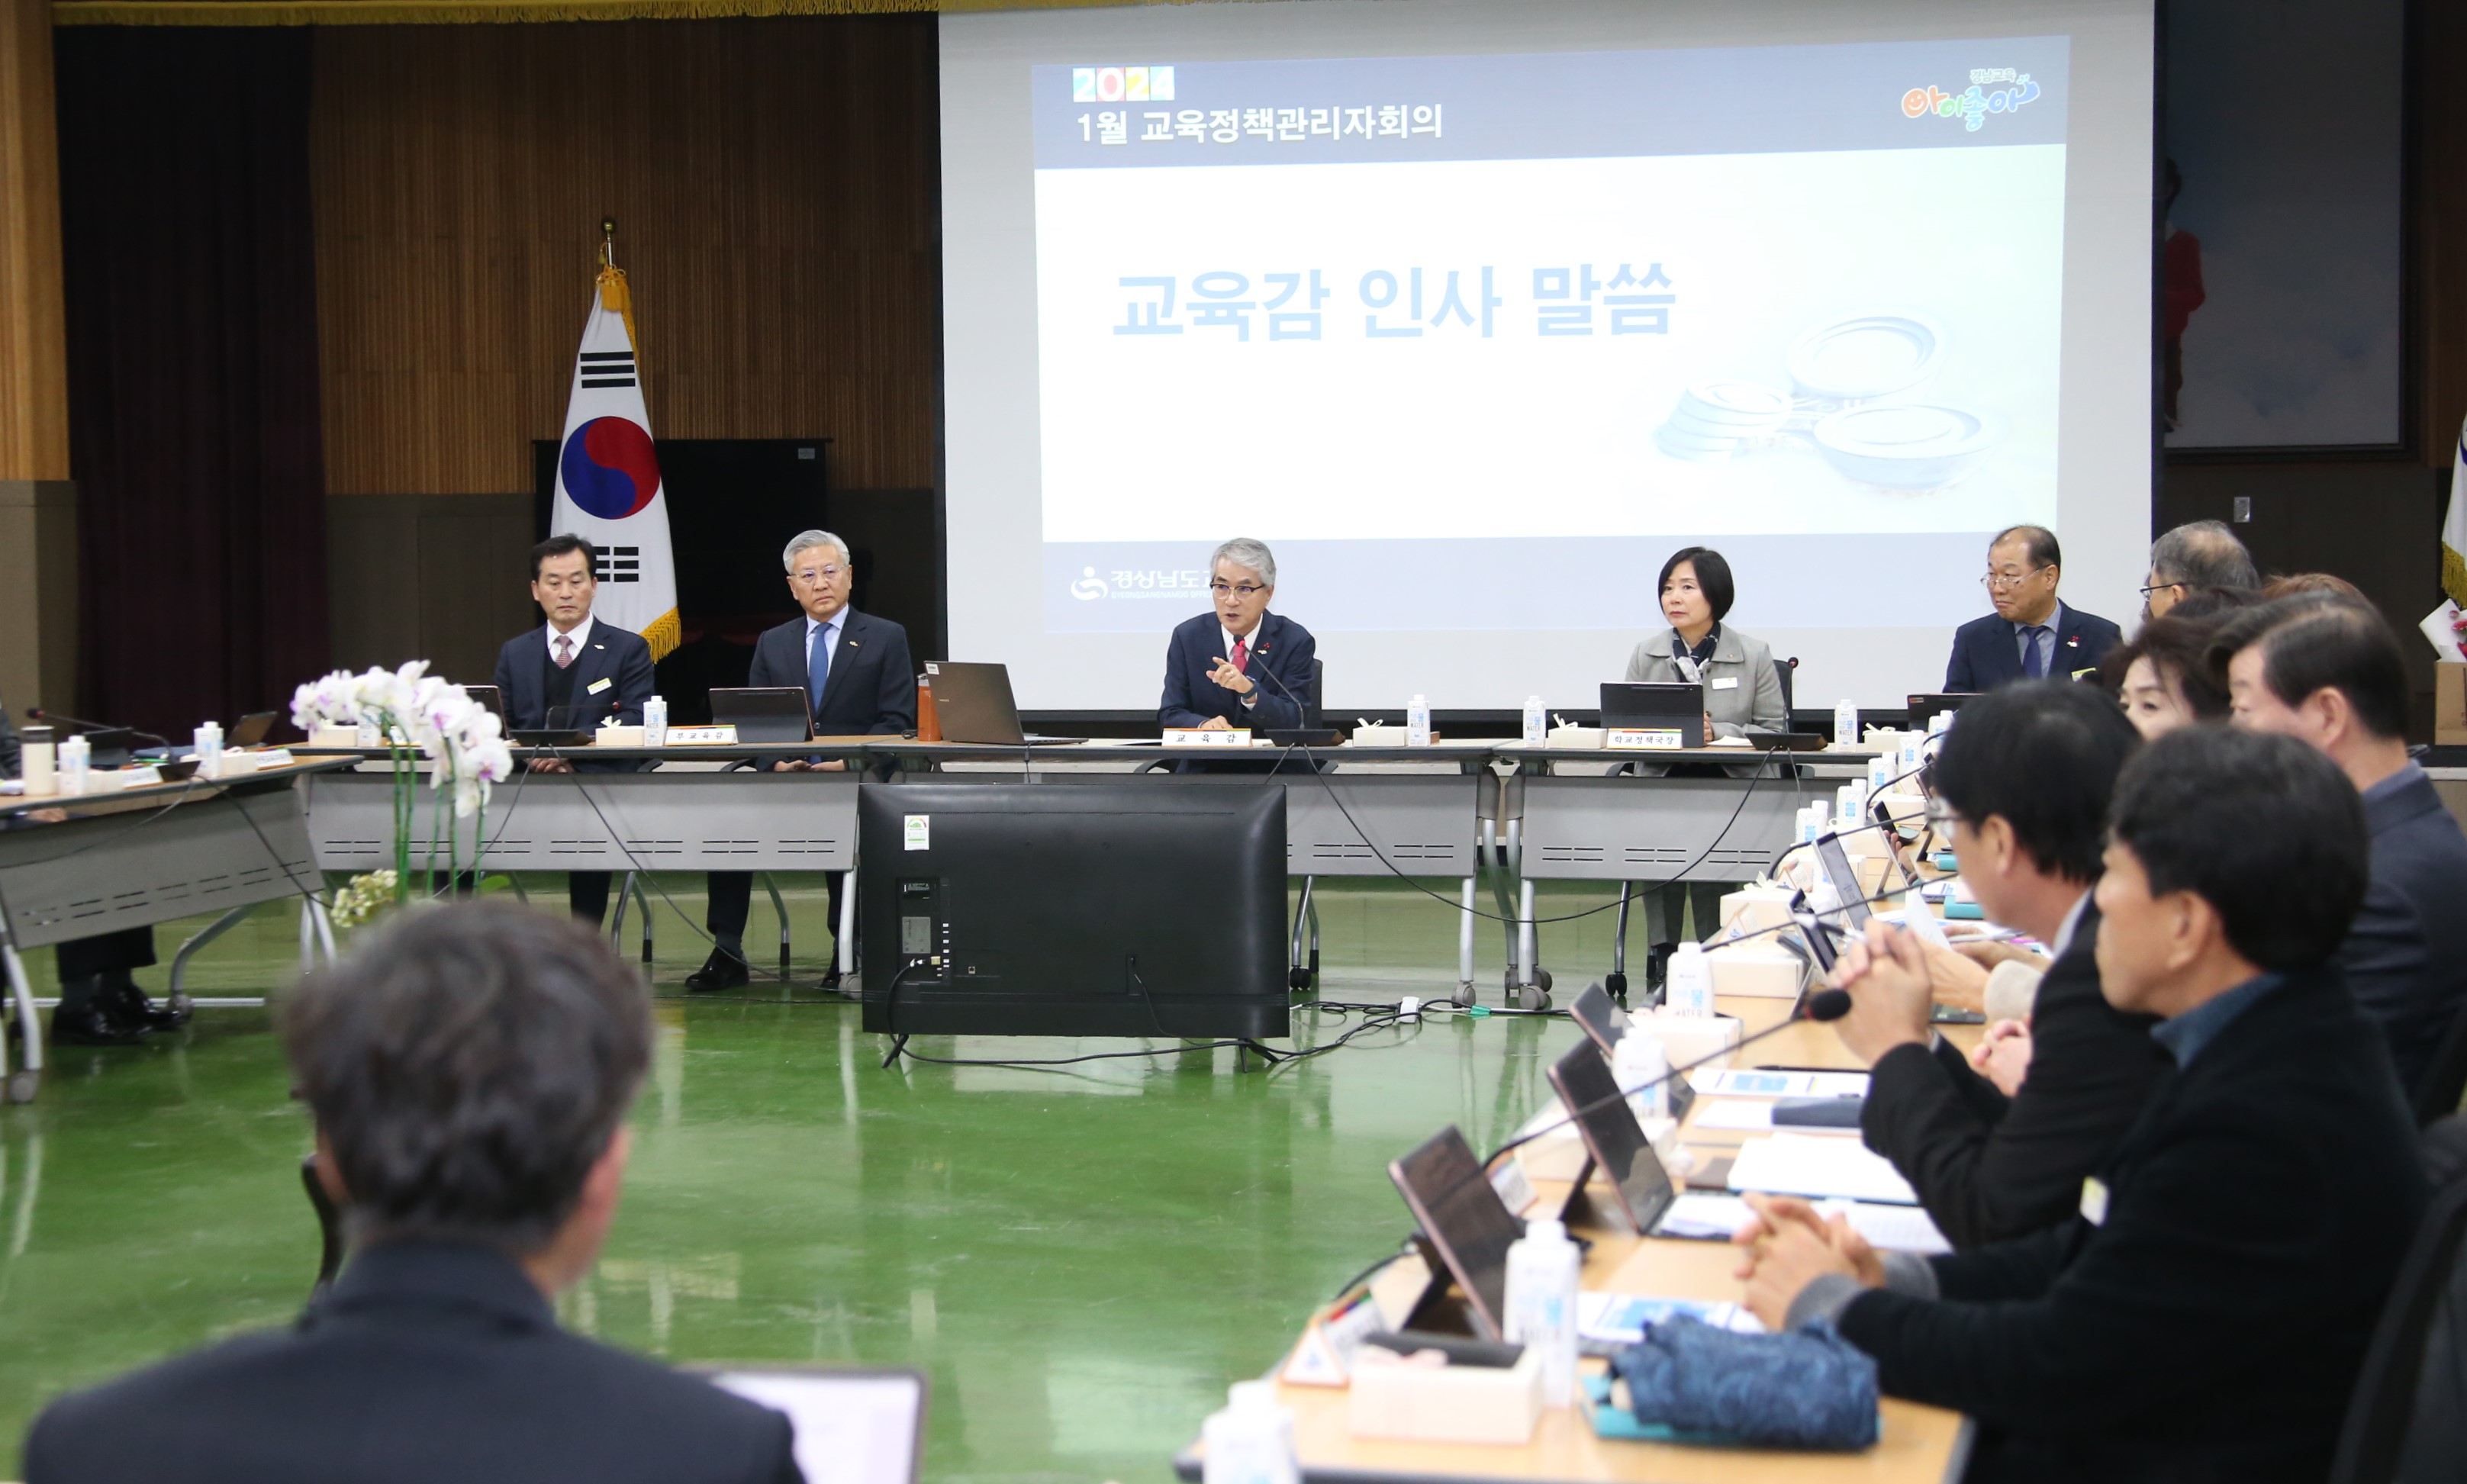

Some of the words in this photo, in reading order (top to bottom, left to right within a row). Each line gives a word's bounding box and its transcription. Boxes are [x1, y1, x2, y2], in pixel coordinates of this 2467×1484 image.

[1073, 66, 1175, 102] 2024
[1077, 110, 1128, 145] 1월
[1140, 103, 1444, 143] 교육정책관리자회의
[1113, 269, 1331, 342] 교육감
[1357, 265, 1502, 338] 인사
[1531, 262, 1676, 336] 말씀
[1190, 590, 1213, 599] OFFIC
[1614, 735, 1675, 745] 학교정책국장
